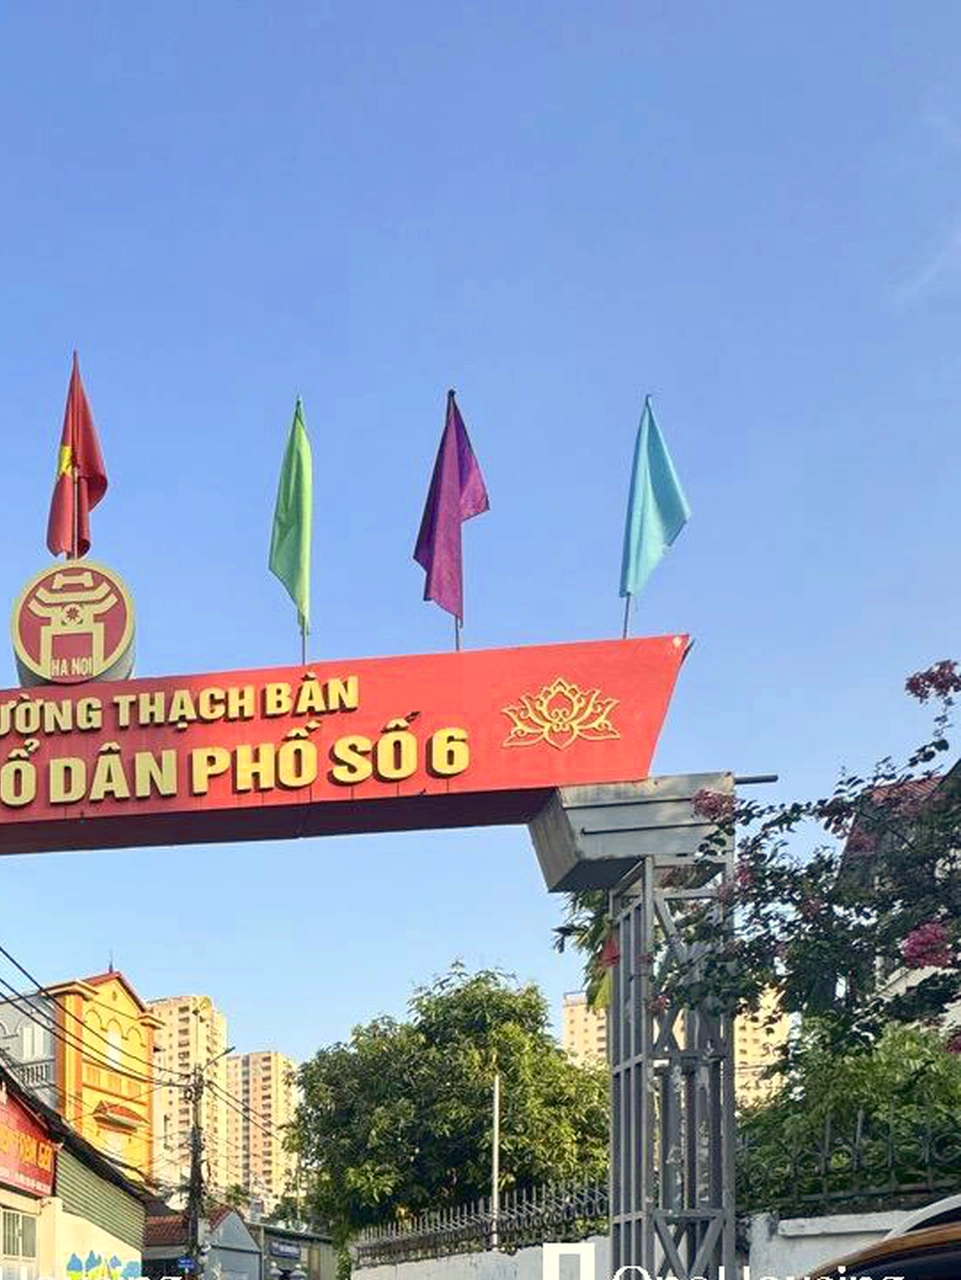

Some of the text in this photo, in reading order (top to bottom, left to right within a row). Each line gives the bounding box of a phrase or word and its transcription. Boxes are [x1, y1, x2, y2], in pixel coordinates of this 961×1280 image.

[113, 686, 255, 730] THẠCH
[49, 741, 177, 804] DÂN
[192, 719, 319, 796] PHỐ
[331, 711, 421, 784] SỐ
[431, 727, 470, 776] 6
